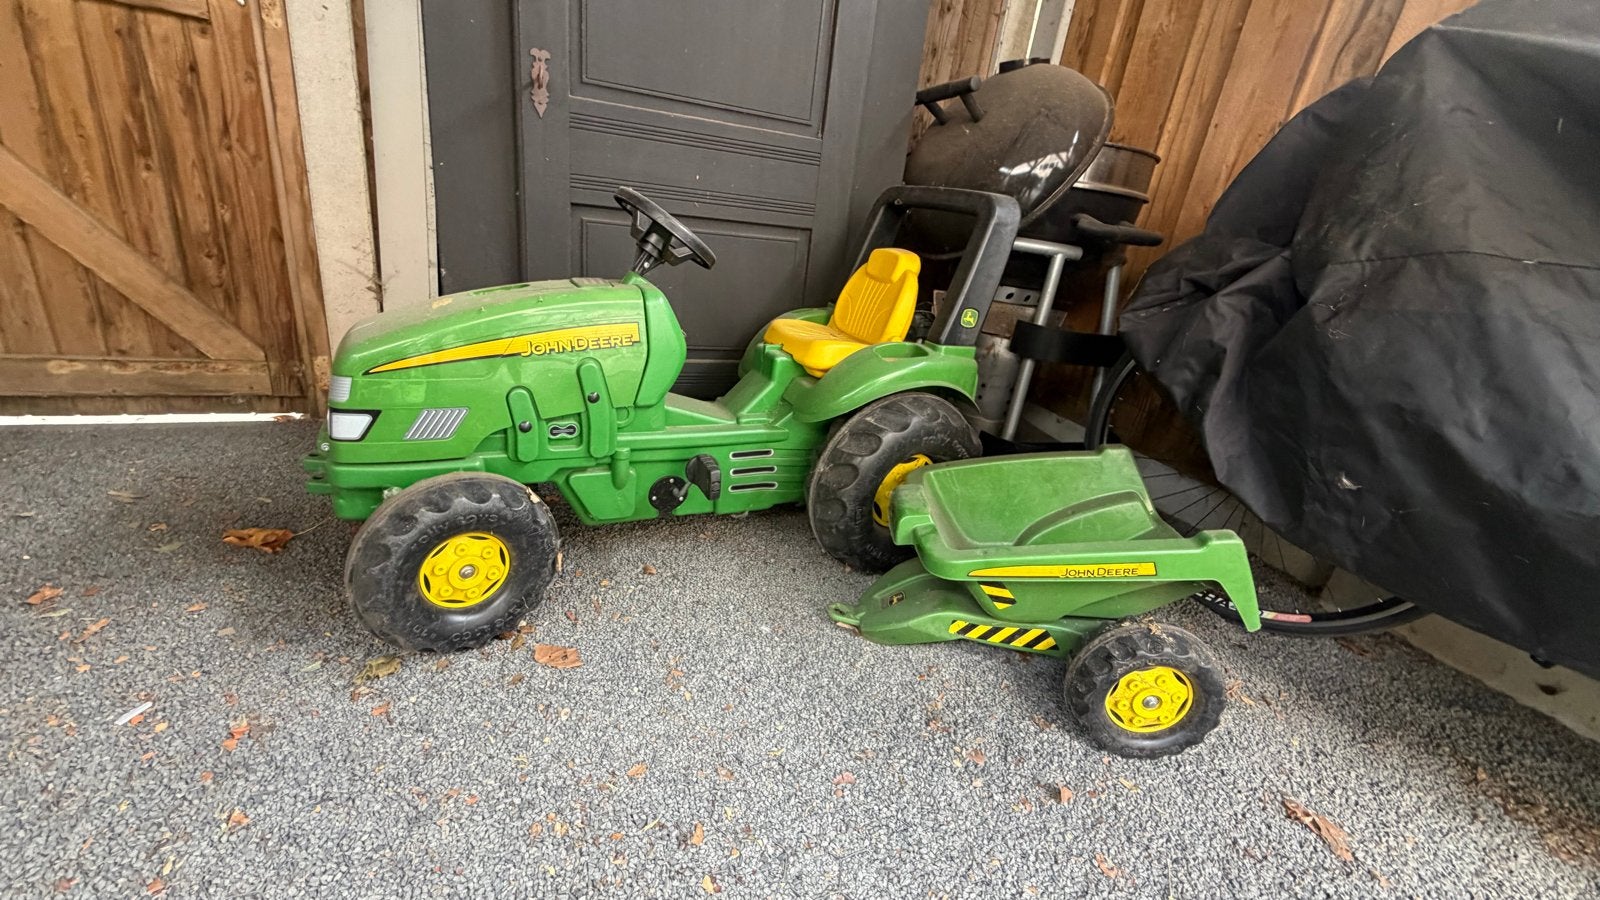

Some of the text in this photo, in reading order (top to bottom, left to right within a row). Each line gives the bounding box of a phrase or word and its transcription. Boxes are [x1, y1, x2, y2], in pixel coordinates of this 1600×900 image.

[520, 334, 634, 357] JOHN DEERE
[1061, 567, 1139, 577] JOHN DEERE
